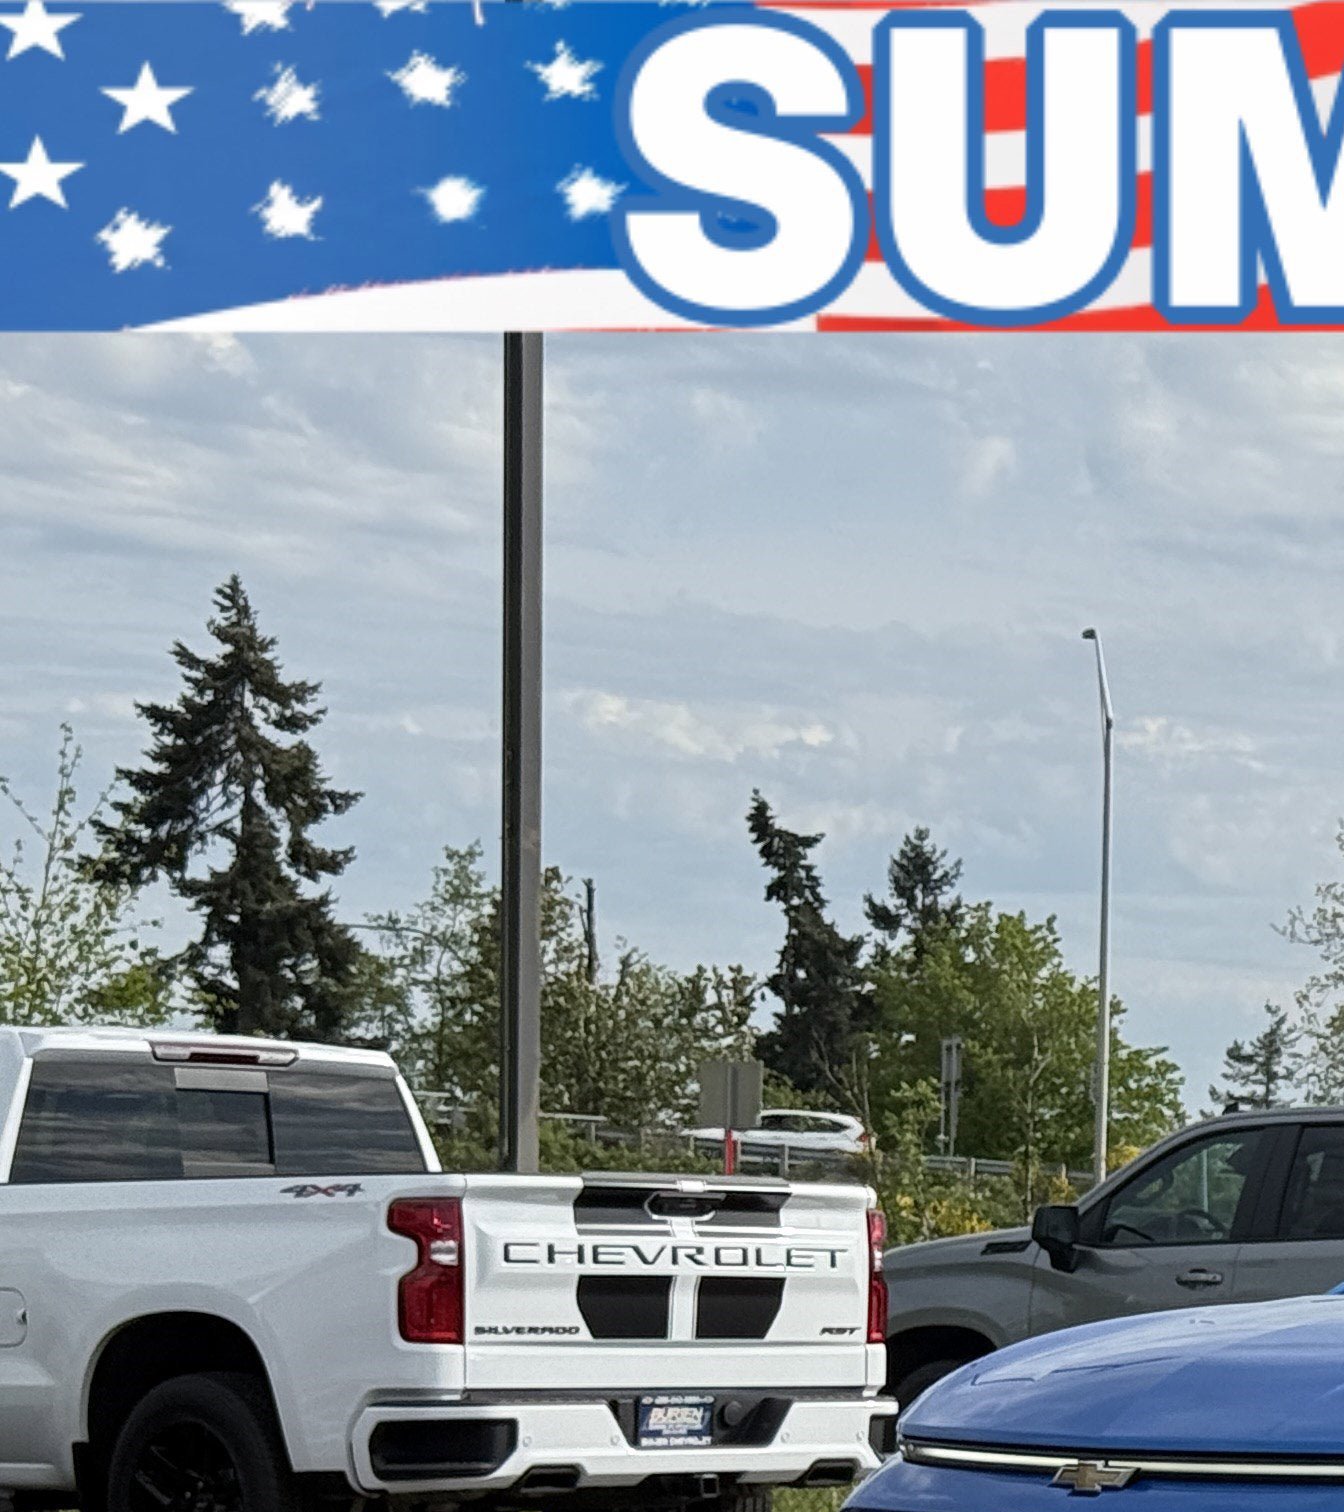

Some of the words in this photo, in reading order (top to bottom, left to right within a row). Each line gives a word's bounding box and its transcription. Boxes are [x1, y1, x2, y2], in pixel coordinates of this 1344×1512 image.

[503, 1241, 849, 1269] CHEVROLET
[474, 1326, 580, 1335] SILVERADO
[819, 1326, 862, 1336] RST
